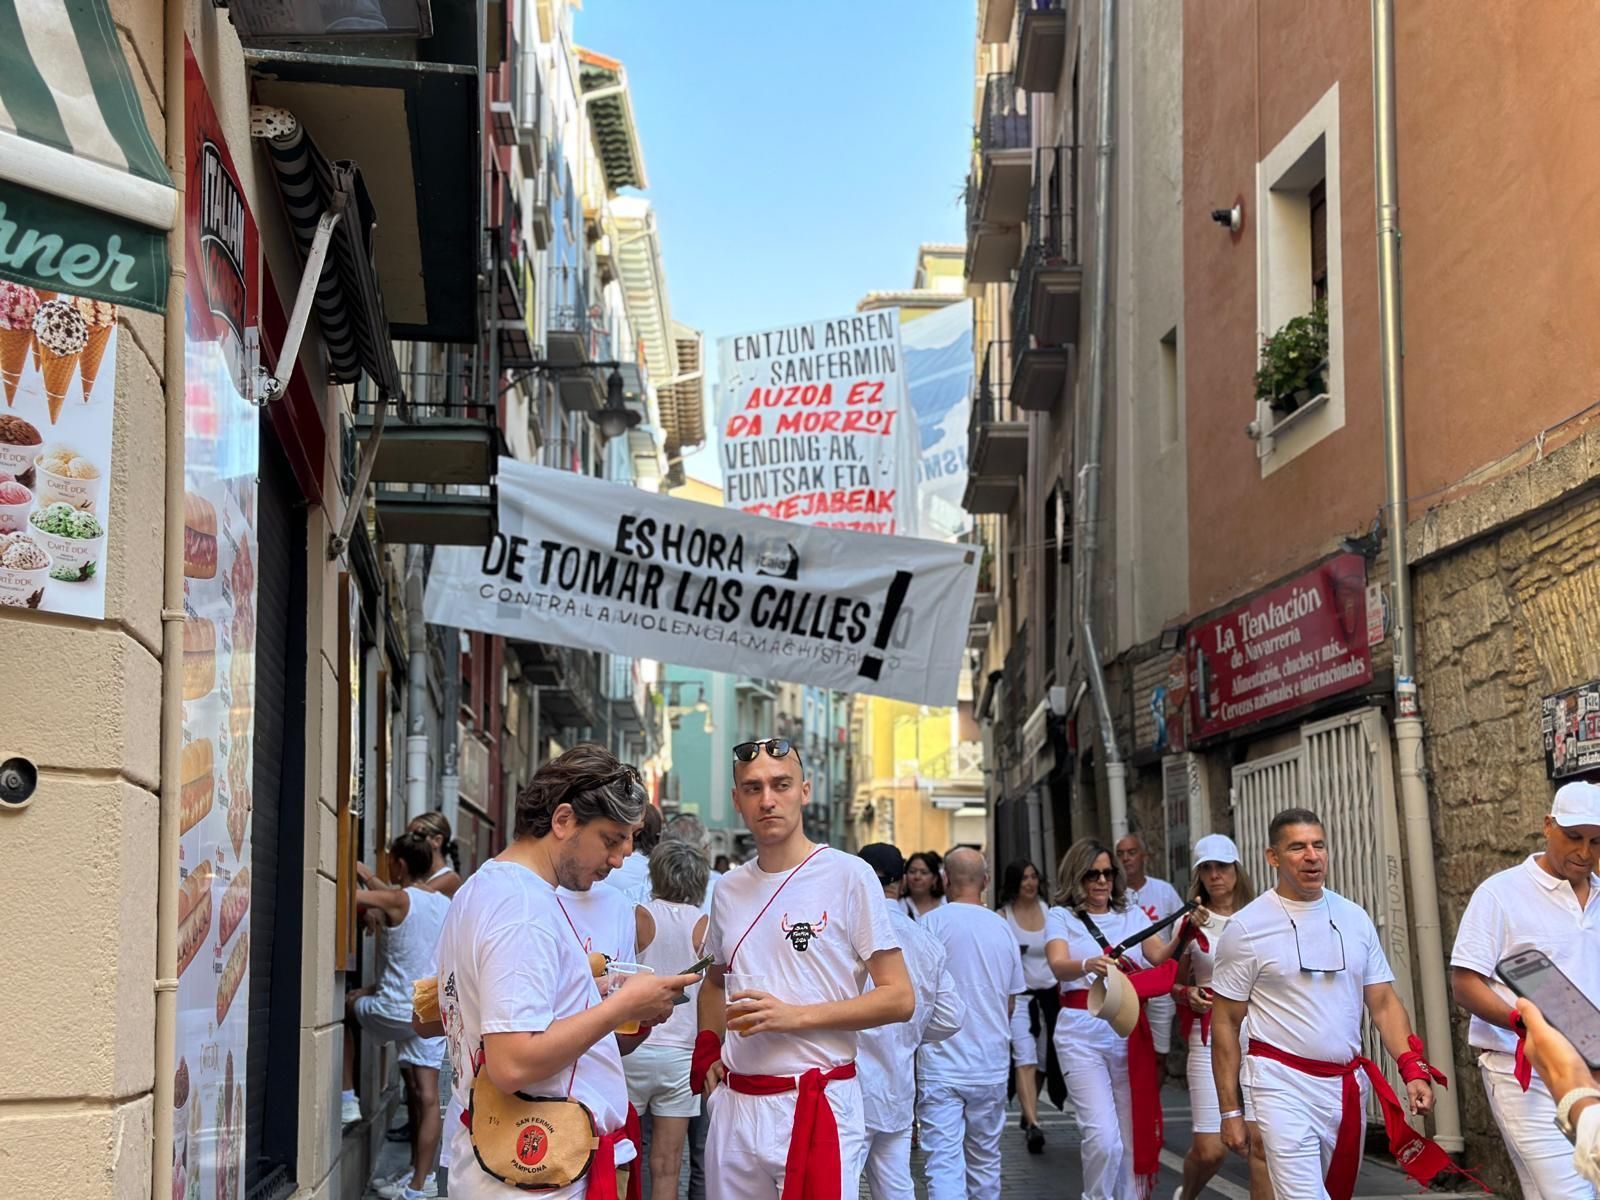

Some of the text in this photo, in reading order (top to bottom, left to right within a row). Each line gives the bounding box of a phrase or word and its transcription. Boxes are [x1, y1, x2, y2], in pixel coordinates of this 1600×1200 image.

[734, 311, 893, 362] ENTZUN ARREN
[770, 344, 896, 386] SANFERMIN
[745, 380, 886, 411] AUZOA EZ
[726, 410, 897, 437] DA MORROI
[727, 464, 871, 502] FUNTSAK ETA
[615, 514, 744, 574] ES HORA
[481, 531, 529, 584] DE
[539, 539, 665, 610] TOMAR
[673, 570, 744, 624] LAS
[479, 583, 577, 616] CONTRA
[584, 604, 610, 622] LA
[618, 610, 740, 647] VIOLENCIA
[1215, 624, 1236, 654] La
[1238, 587, 1322, 643] Tentación
[1231, 648, 1244, 670] de
[1221, 655, 1366, 721] Cervezas nacionales e internacionales
[515, 1116, 530, 1128] SAN
[510, 1159, 548, 1174] PAMPLONA
